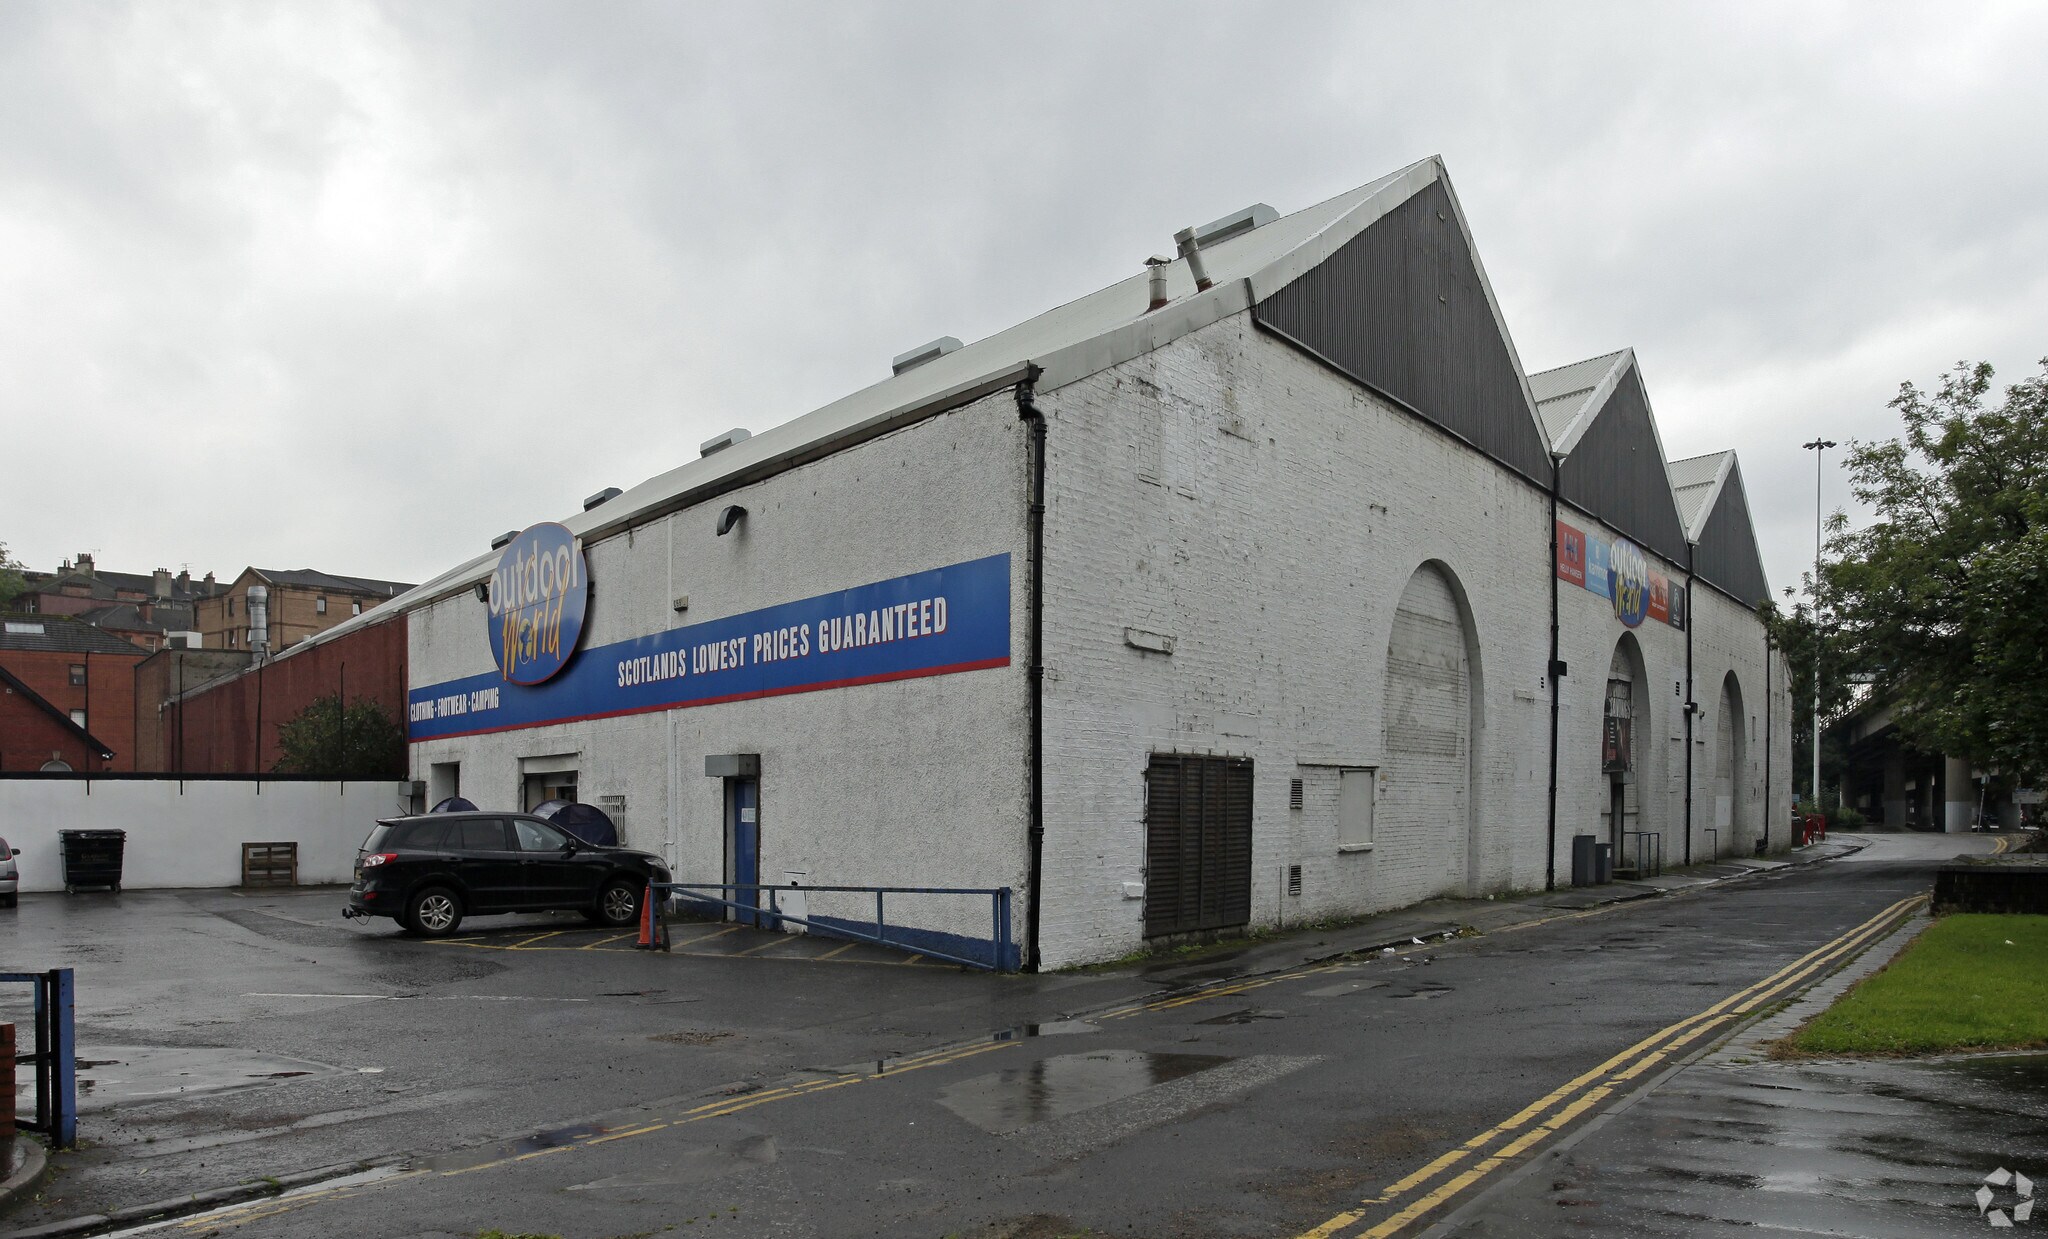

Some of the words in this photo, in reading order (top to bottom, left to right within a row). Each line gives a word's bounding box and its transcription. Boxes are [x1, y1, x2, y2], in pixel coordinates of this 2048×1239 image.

[489, 538, 583, 615] outdoor
[1610, 542, 1647, 587] outdoor
[503, 552, 570, 681] World
[618, 649, 687, 688] SCOTLANDS
[693, 637, 747, 675] LOWEST
[753, 623, 810, 664] PRICES
[818, 596, 948, 653] GUARANTEED
[410, 700, 434, 722] CLOTHING
[437, 694, 467, 718] FOOTWEAR
[471, 687, 499, 713] CAMPING
